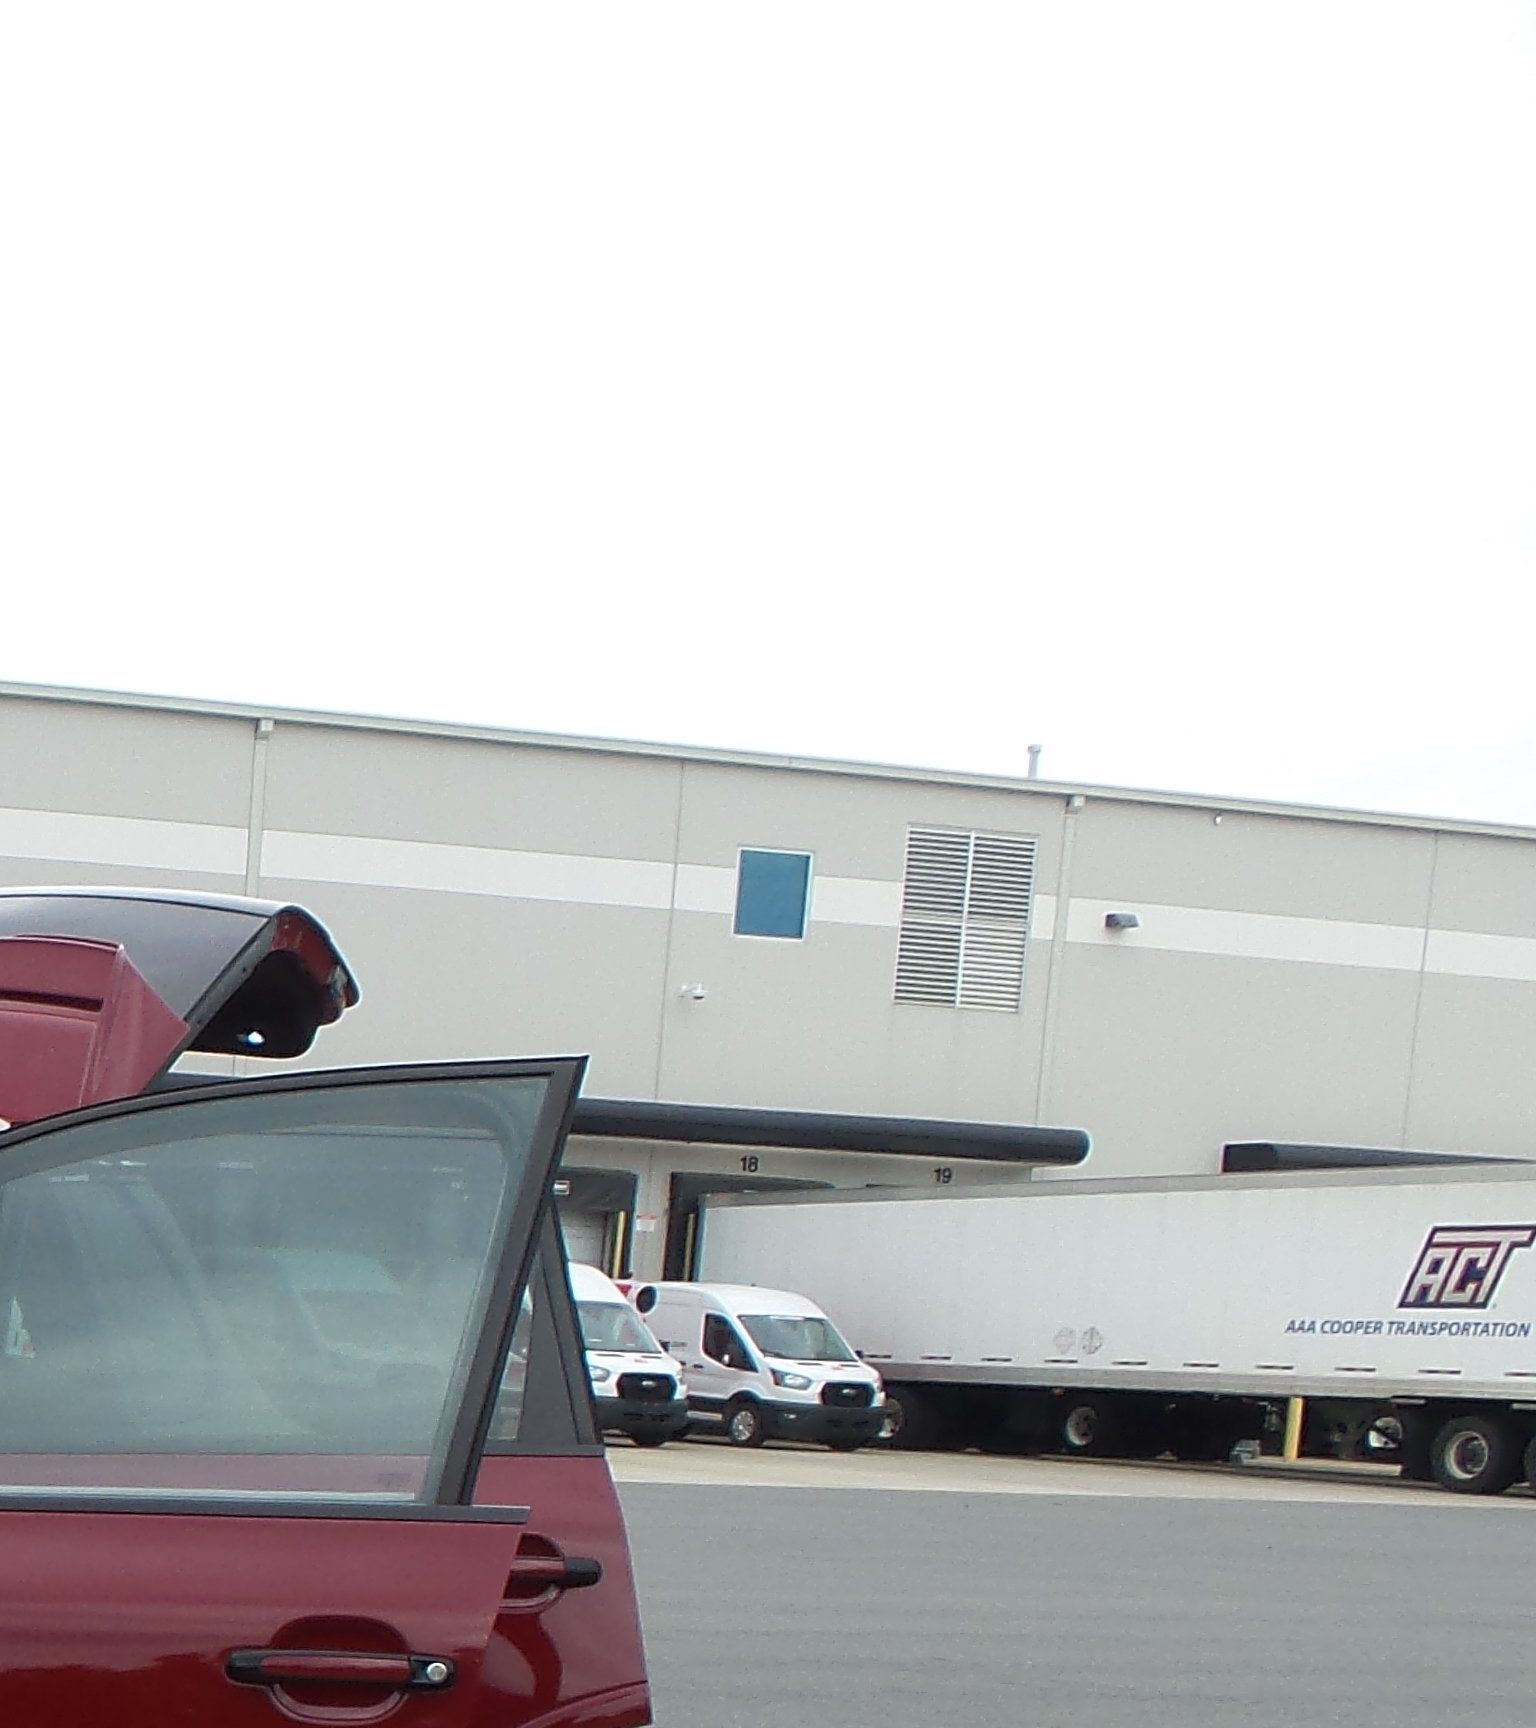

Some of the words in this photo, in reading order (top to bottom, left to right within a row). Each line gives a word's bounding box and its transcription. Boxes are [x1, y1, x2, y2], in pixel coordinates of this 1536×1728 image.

[740, 1155, 759, 1172] 18
[933, 1167, 952, 1184] 19
[1398, 1225, 1536, 1309] ACT
[1285, 1319, 1317, 1334] AAA
[1320, 1319, 1384, 1335] COOPER
[1386, 1320, 1532, 1338] TRANSPORTATION
